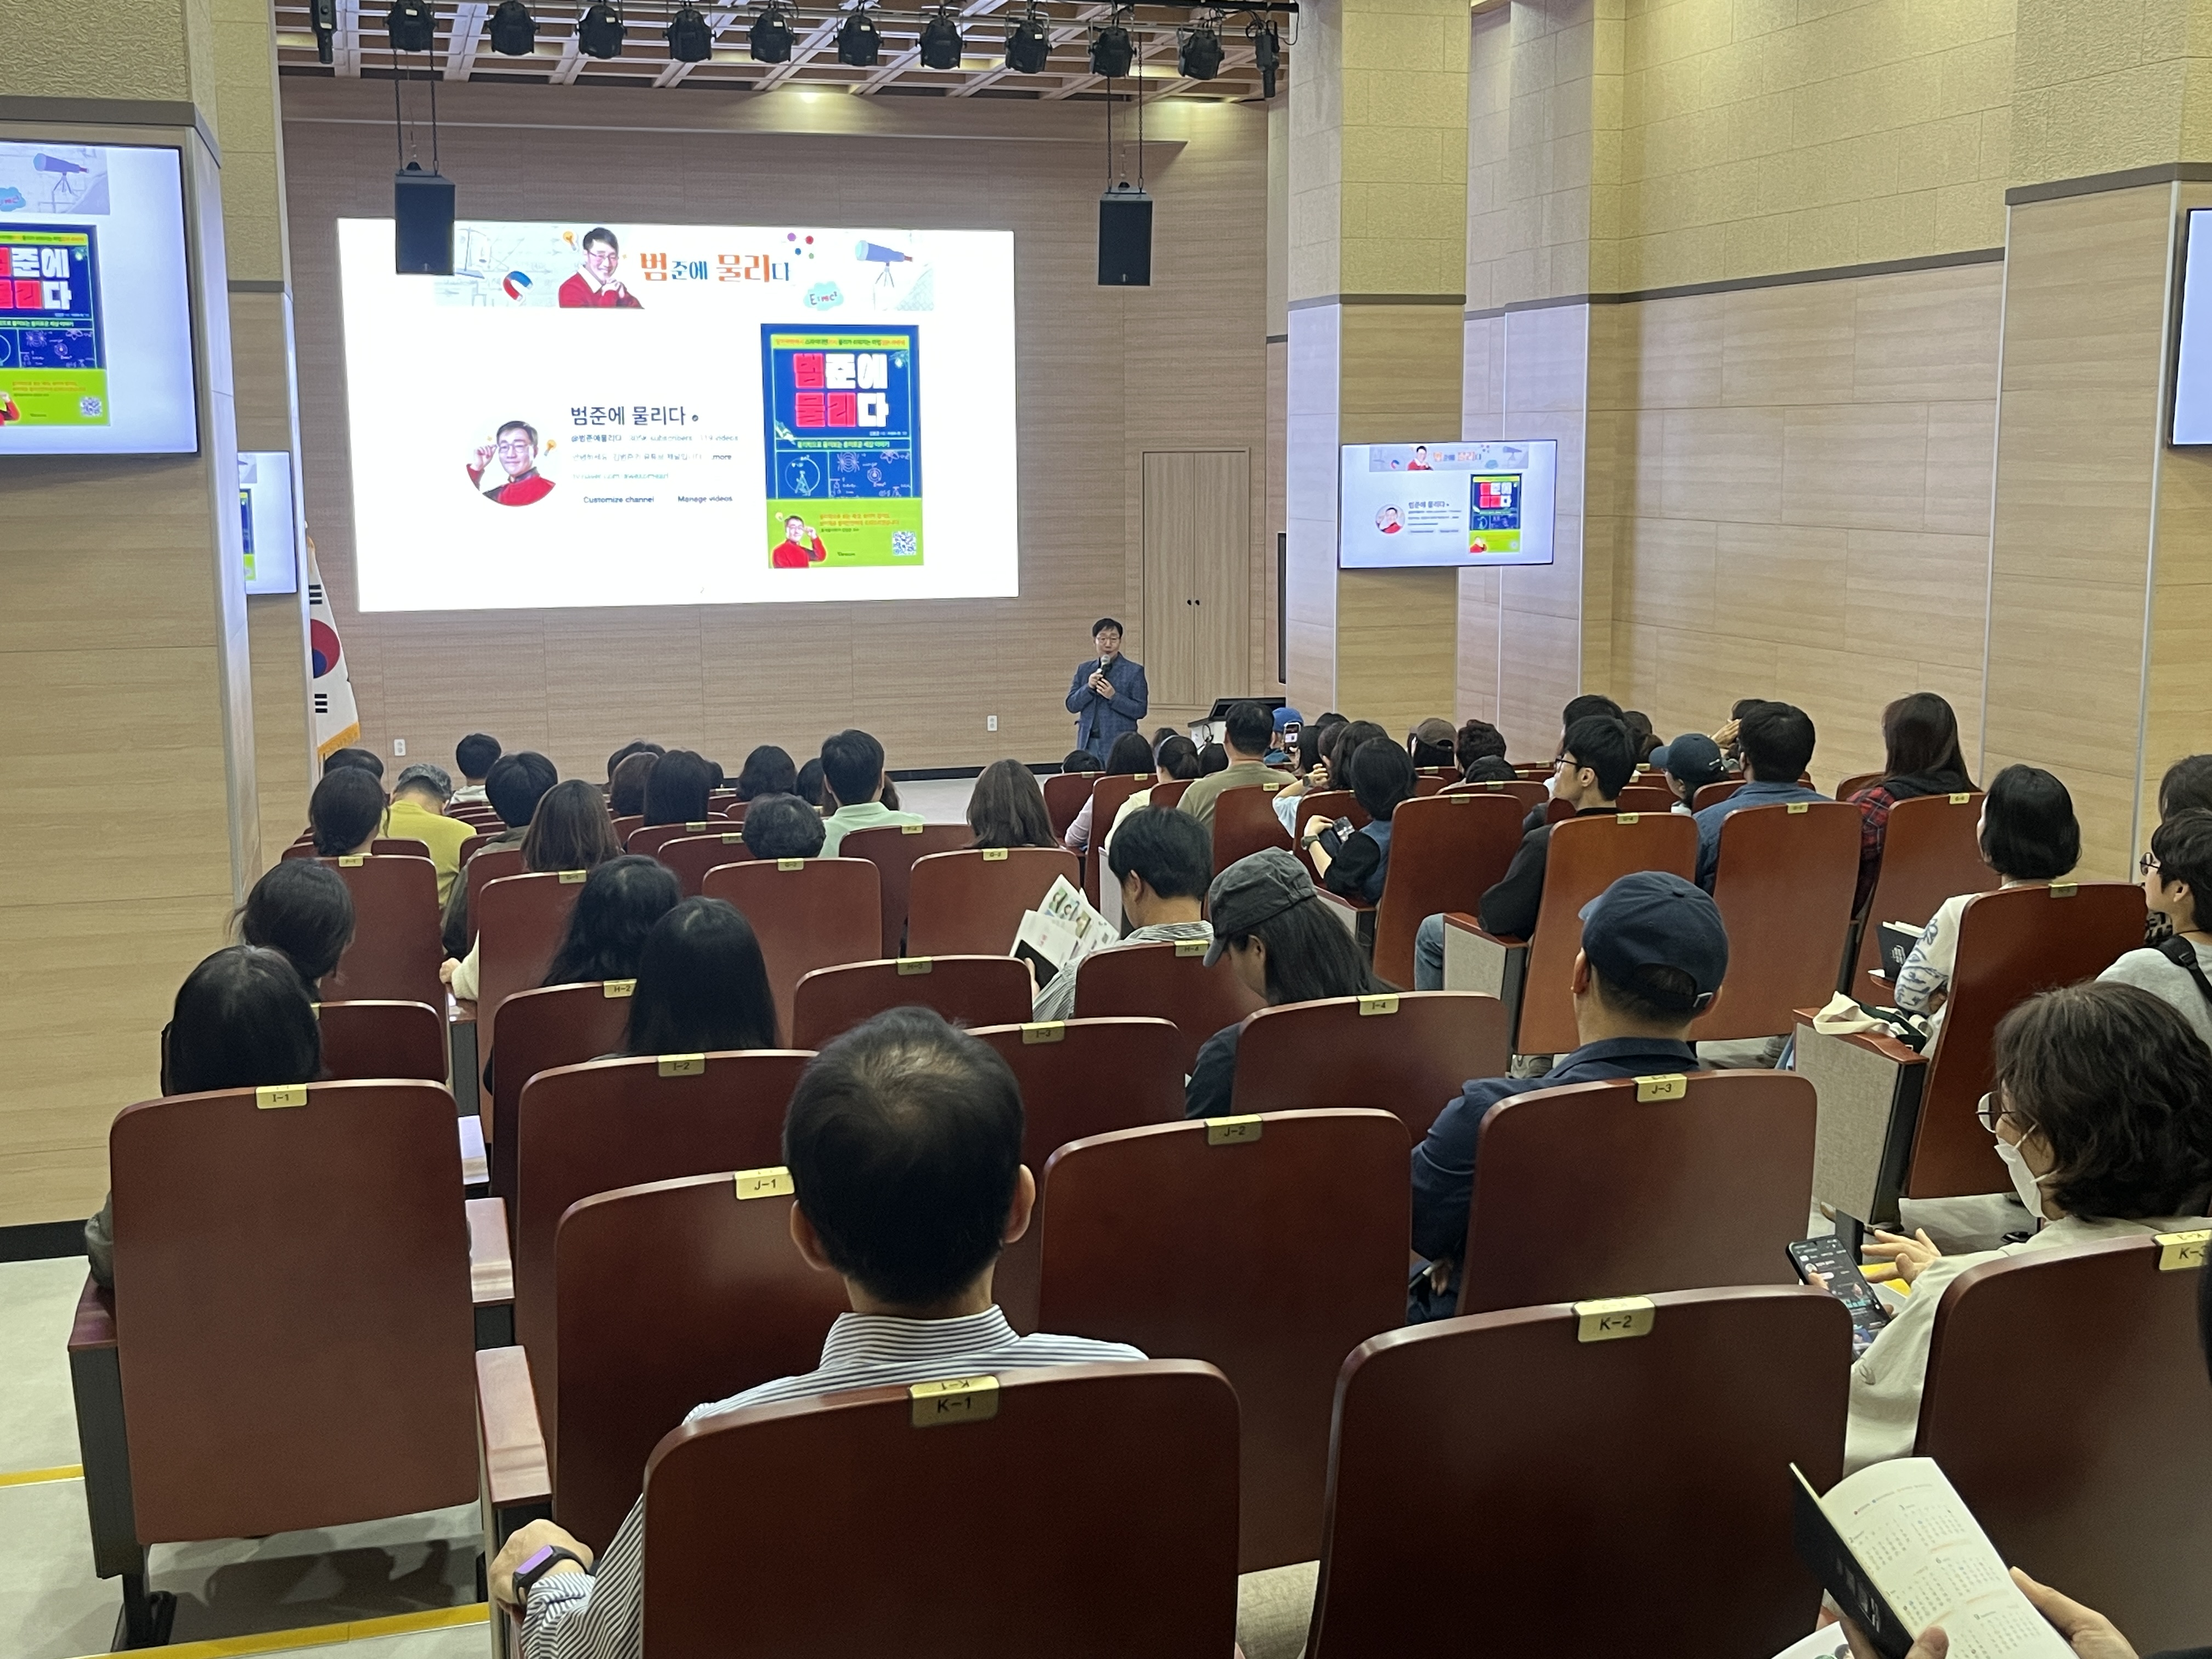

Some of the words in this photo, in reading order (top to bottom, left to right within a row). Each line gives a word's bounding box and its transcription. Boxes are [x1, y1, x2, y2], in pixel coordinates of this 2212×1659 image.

[640, 252, 708, 281] 범준에
[715, 254, 791, 283] 물리다
[793, 353, 889, 390] 범준에
[571, 406, 625, 426] 범준에
[631, 406, 686, 426] 물리다
[794, 392, 889, 427] 물리다
[1372, 1001, 1386, 1010] I-4
[1035, 1029, 1051, 1039] I-3
[673, 1062, 690, 1071] I-2
[1651, 1083, 1672, 1095] J-3
[272, 1093, 289, 1103] I-1
[1223, 1125, 1245, 1137] J-2
[754, 1178, 777, 1191] J-1
[1599, 1314, 1633, 1331] K-2
[936, 1397, 971, 1414] K-1
